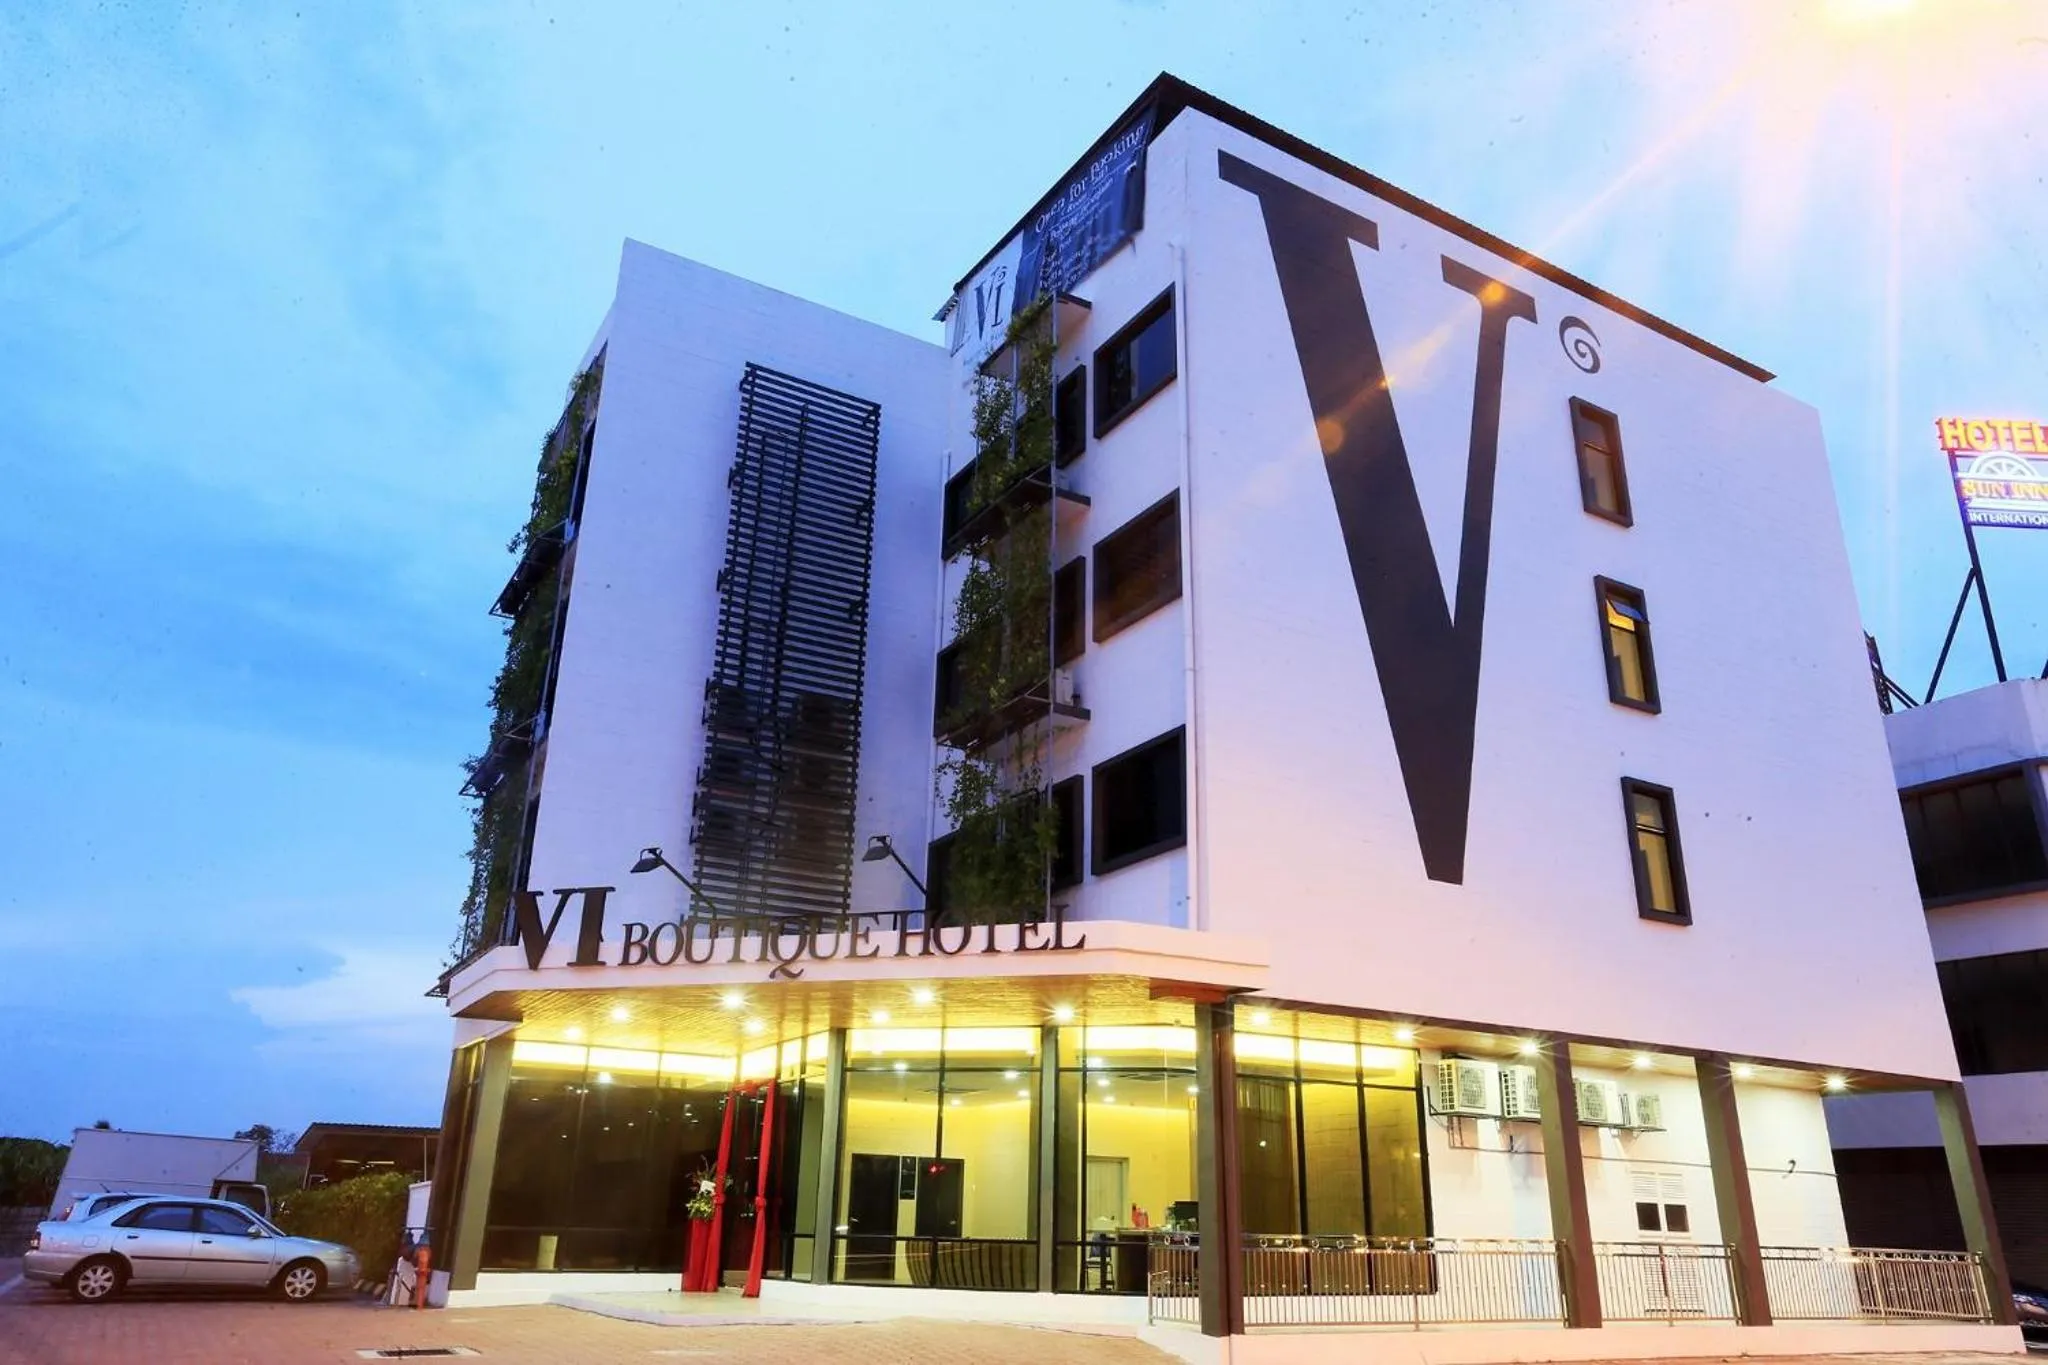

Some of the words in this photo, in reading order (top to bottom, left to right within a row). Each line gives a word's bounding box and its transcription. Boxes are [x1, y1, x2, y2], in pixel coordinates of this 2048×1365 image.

[1069, 177, 1088, 201] for
[1936, 417, 2048, 454] HOTEL
[1961, 480, 2006, 499] SUN
[514, 886, 616, 971] VI
[617, 912, 880, 979] BOUTIQUE
[894, 903, 1086, 957] HOTEL
